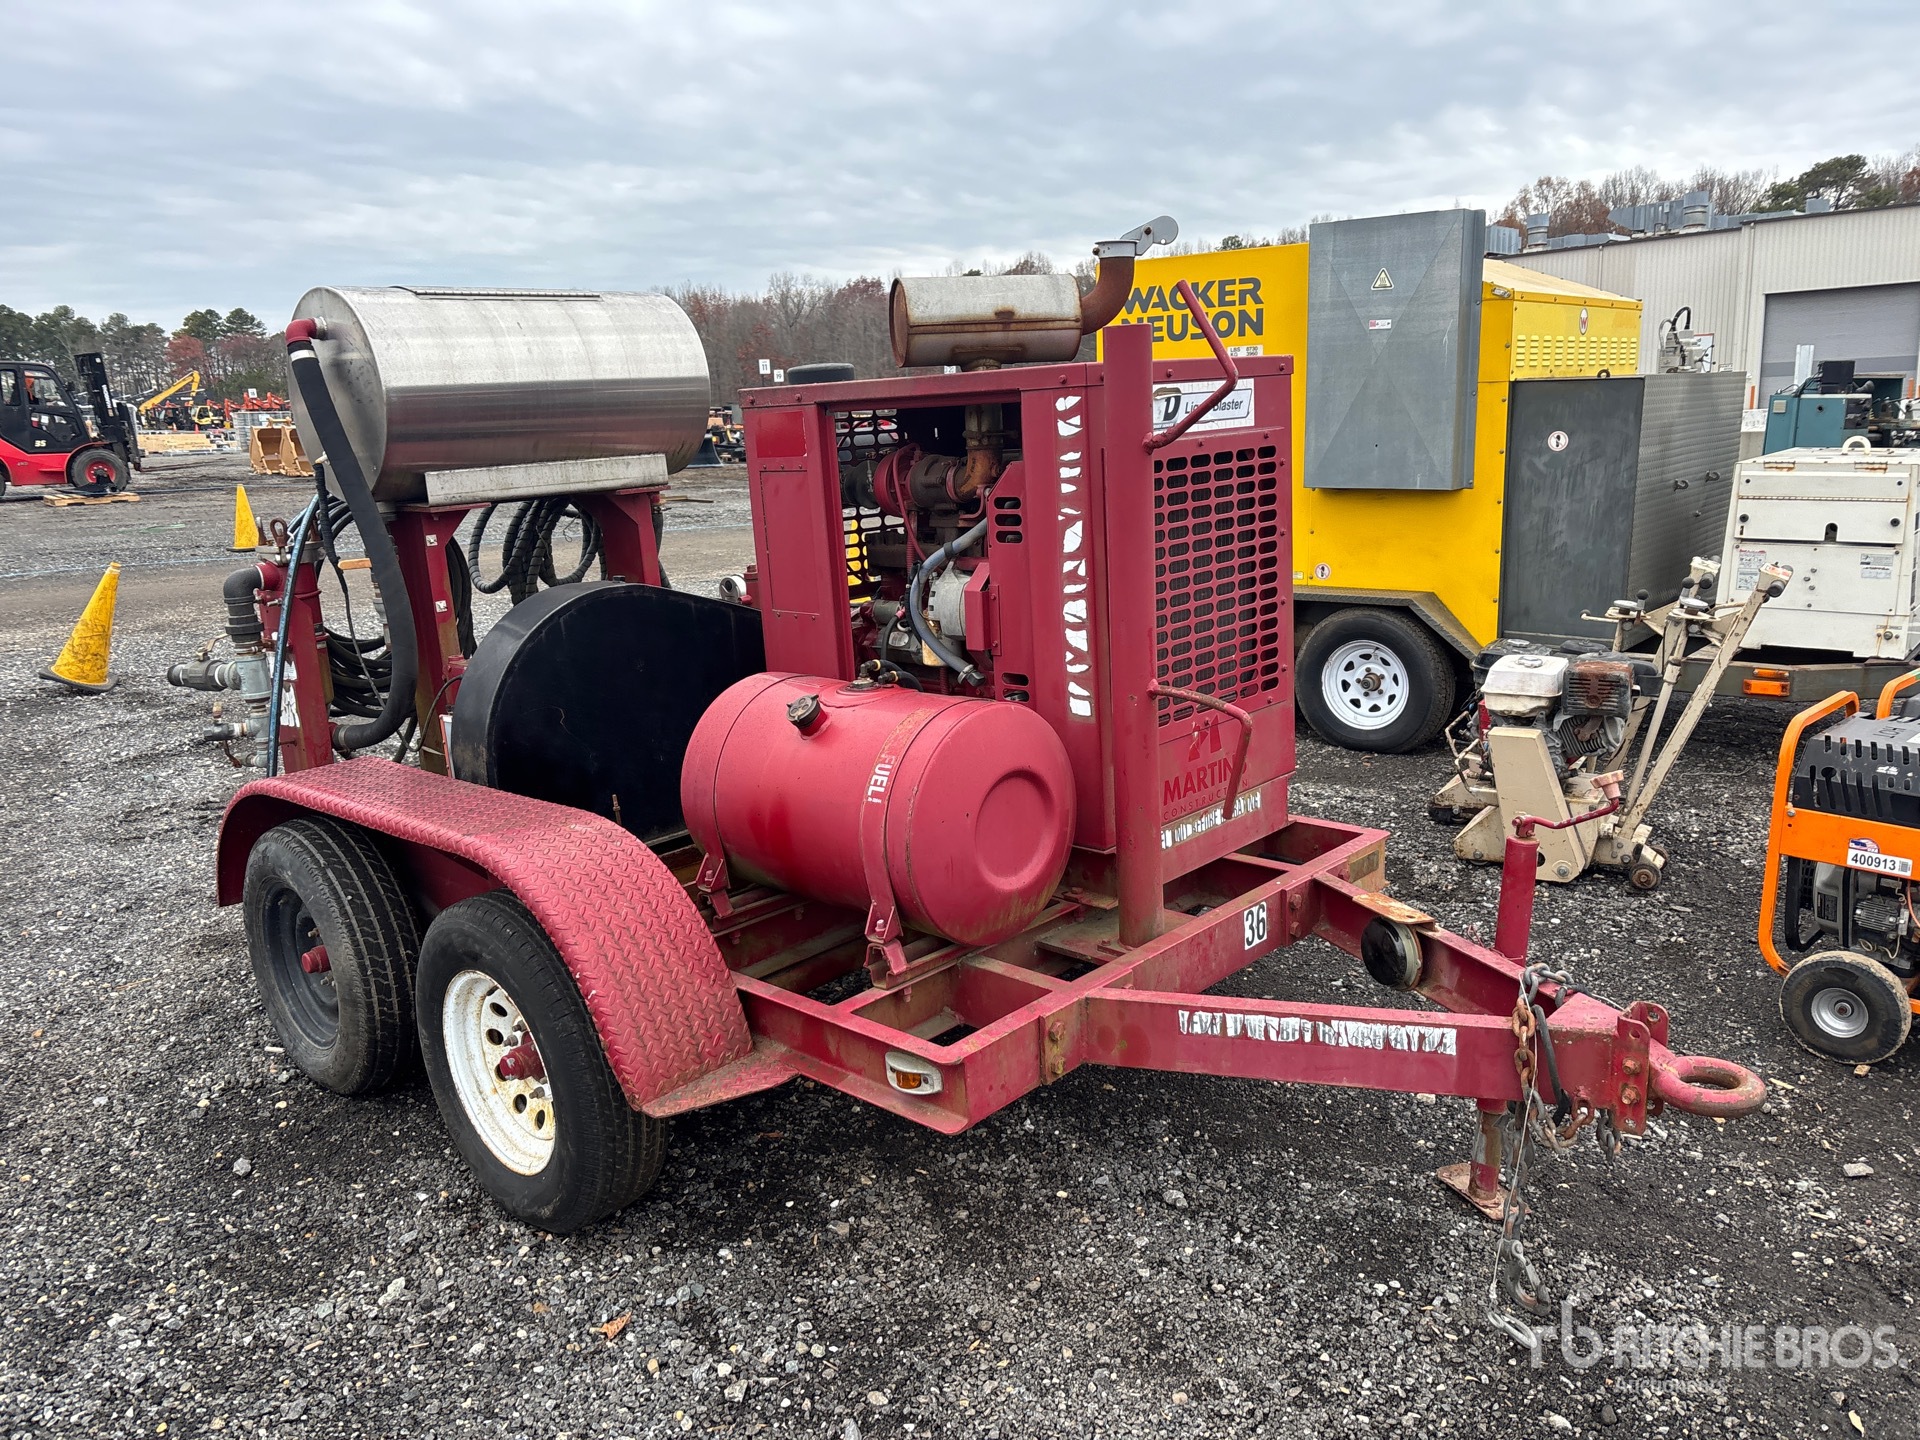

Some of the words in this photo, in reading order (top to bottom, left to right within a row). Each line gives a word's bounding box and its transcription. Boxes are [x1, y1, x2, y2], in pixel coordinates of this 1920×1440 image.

[1124, 277, 1264, 314] WACKER
[1121, 308, 1264, 342] EUSON
[1851, 852, 1896, 871] 400913
[1245, 903, 1266, 947] 36
